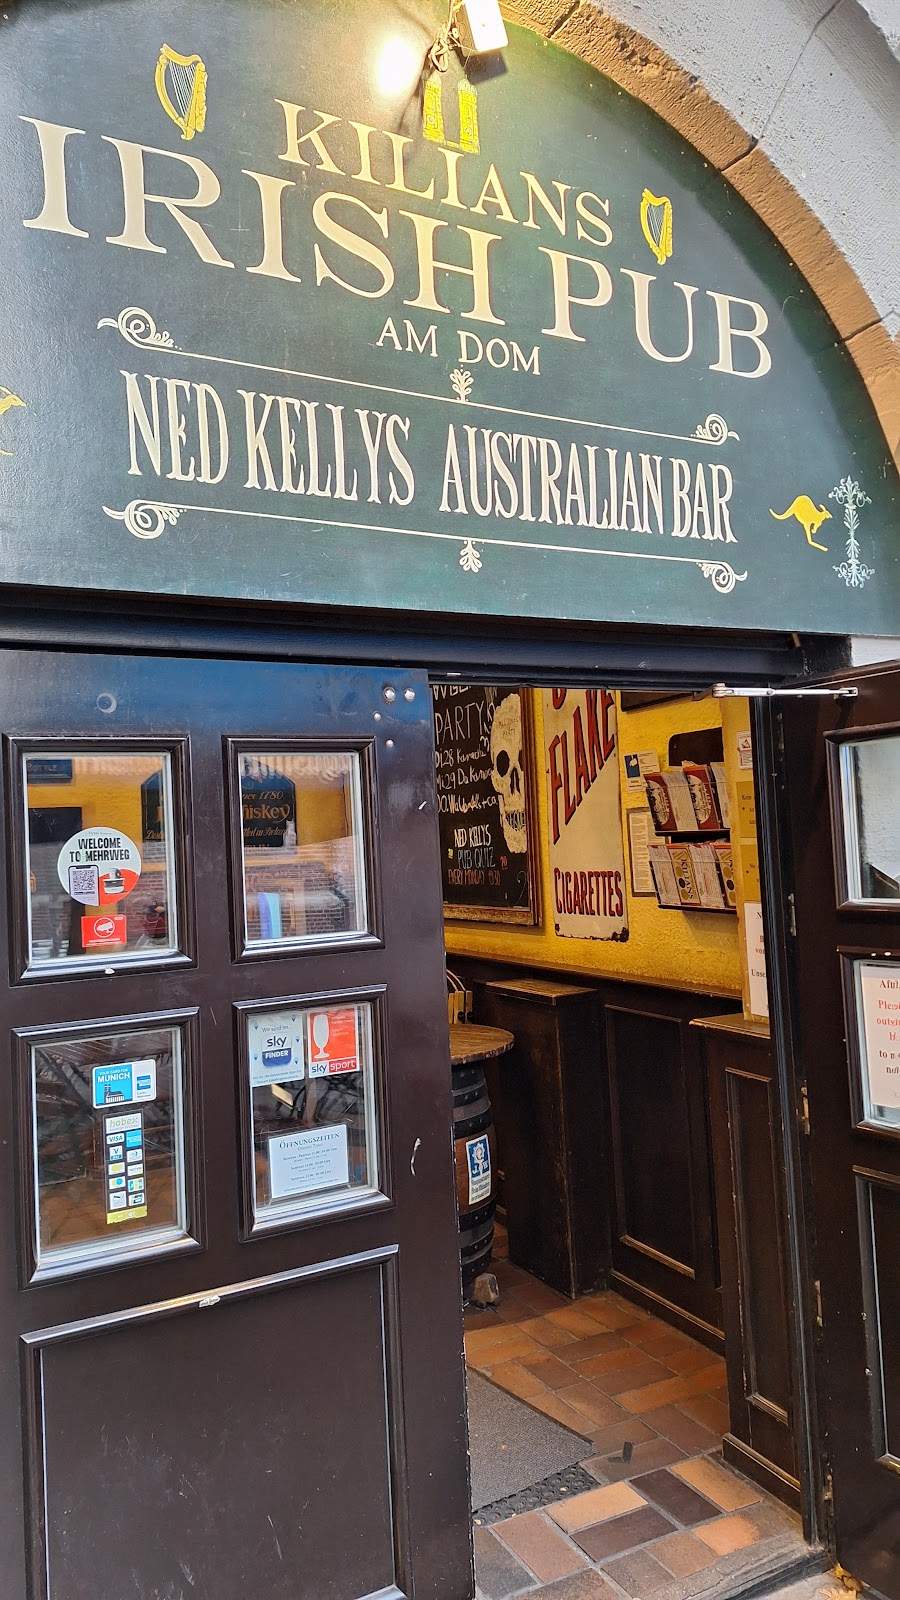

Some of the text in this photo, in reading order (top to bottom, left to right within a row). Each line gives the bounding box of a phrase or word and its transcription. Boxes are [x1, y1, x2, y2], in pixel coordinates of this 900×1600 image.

[275, 98, 614, 247] KILIANS
[20, 115, 773, 380] IRISH PUB
[376, 316, 542, 376] AM DOM
[120, 370, 737, 544] NED KELLYS AUSTRALIAN BAR
[435, 700, 484, 745] PARTY
[548, 689, 617, 846] FLAKE
[78, 838, 121, 849] WELCOME
[69, 849, 130, 862] TO MEHRWEG
[458, 847, 496, 869] PUB QUIZ
[553, 867, 624, 917] CIGARETTES
[267, 1036, 287, 1048] sky
[265, 1050, 289, 1059] FINDER
[98, 1072, 131, 1083] MUNICH
[311, 1060, 355, 1074] sky sport
[110, 1117, 138, 1128] hobex
